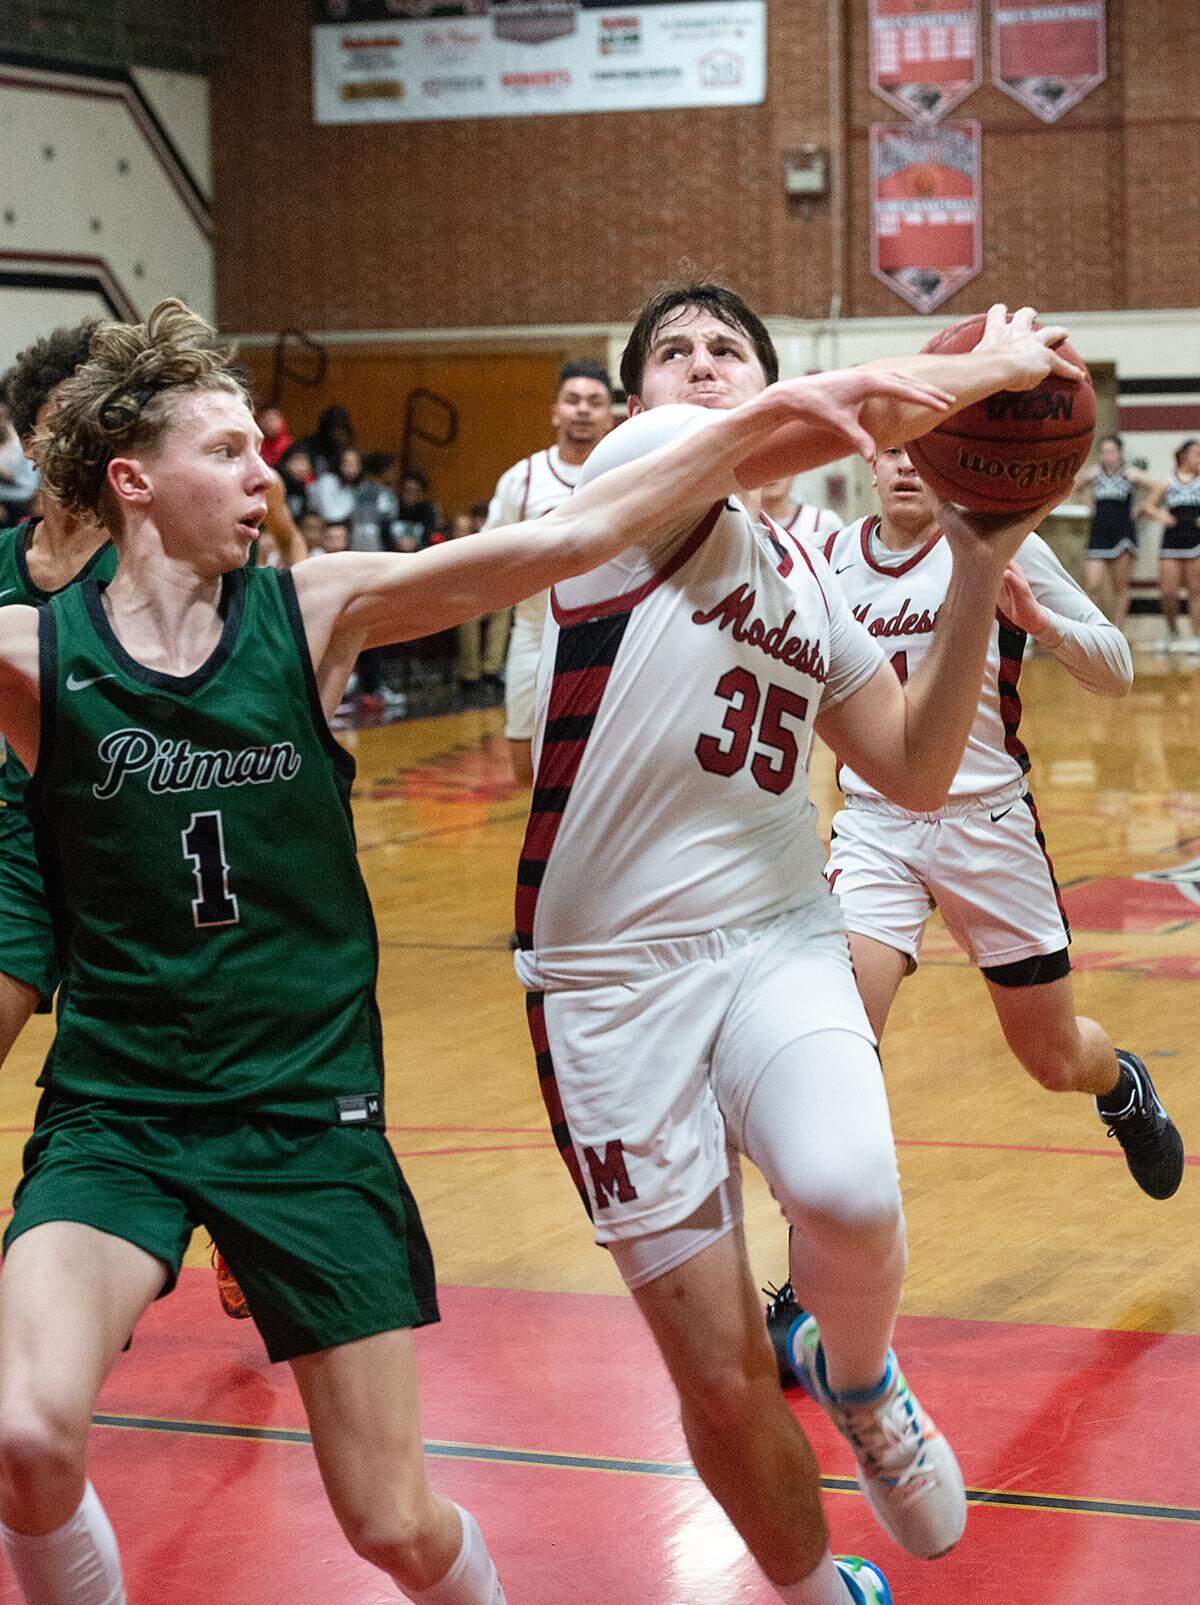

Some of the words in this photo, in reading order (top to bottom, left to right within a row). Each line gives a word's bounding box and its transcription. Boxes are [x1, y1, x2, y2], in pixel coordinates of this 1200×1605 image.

[958, 449, 1081, 489] Wilson
[852, 598, 942, 638] odes
[92, 727, 301, 800] Pitman
[695, 665, 809, 796] 35
[181, 809, 240, 928] 1
[583, 1138, 639, 1210] M
